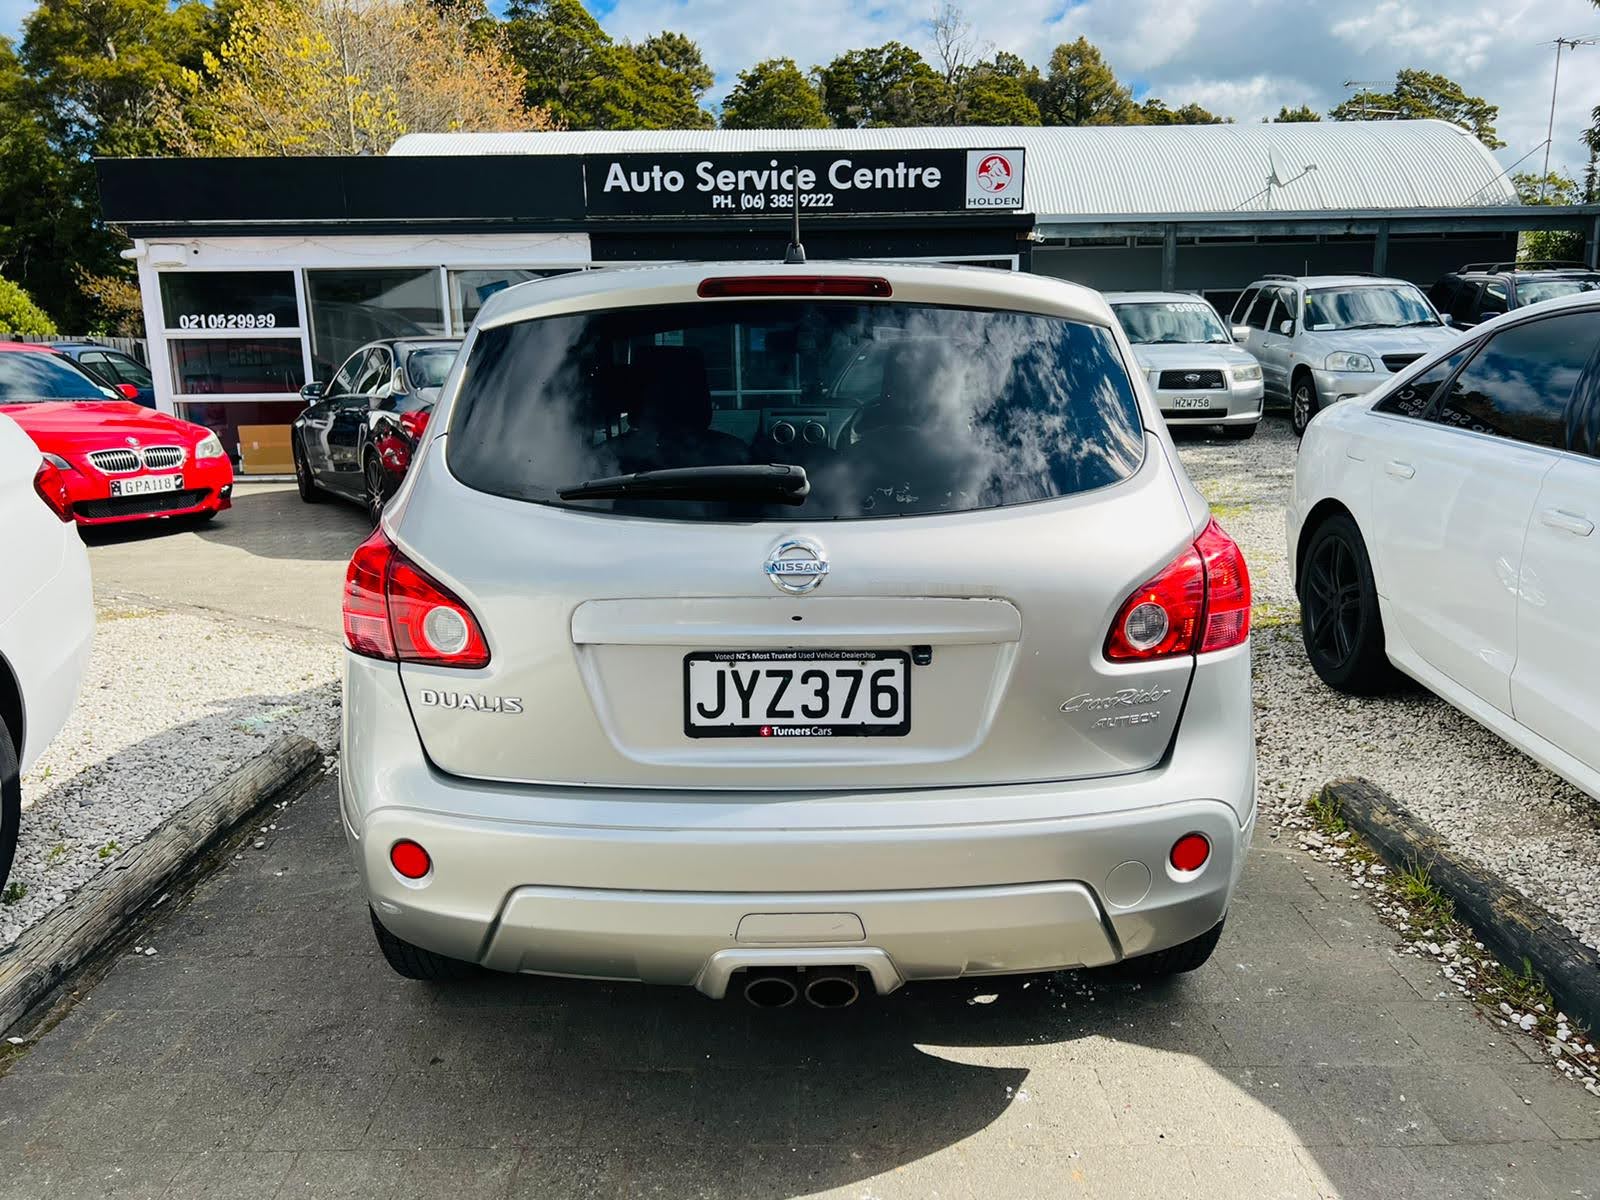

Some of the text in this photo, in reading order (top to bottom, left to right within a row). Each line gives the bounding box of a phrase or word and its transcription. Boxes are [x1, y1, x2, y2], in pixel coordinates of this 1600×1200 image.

[603, 159, 942, 193] Auto Service Centre
[712, 193, 834, 210] PH. (06) 385 9222
[968, 197, 1021, 206] HOLDEN
[1175, 399, 1210, 408] HZW758
[125, 478, 172, 494] GPA118
[771, 562, 823, 571] NISSAN
[841, 652, 877, 660] Dealership
[420, 688, 524, 715] DUALIS
[696, 669, 899, 719] JYZ376
[1091, 711, 1160, 728] AUTECH
